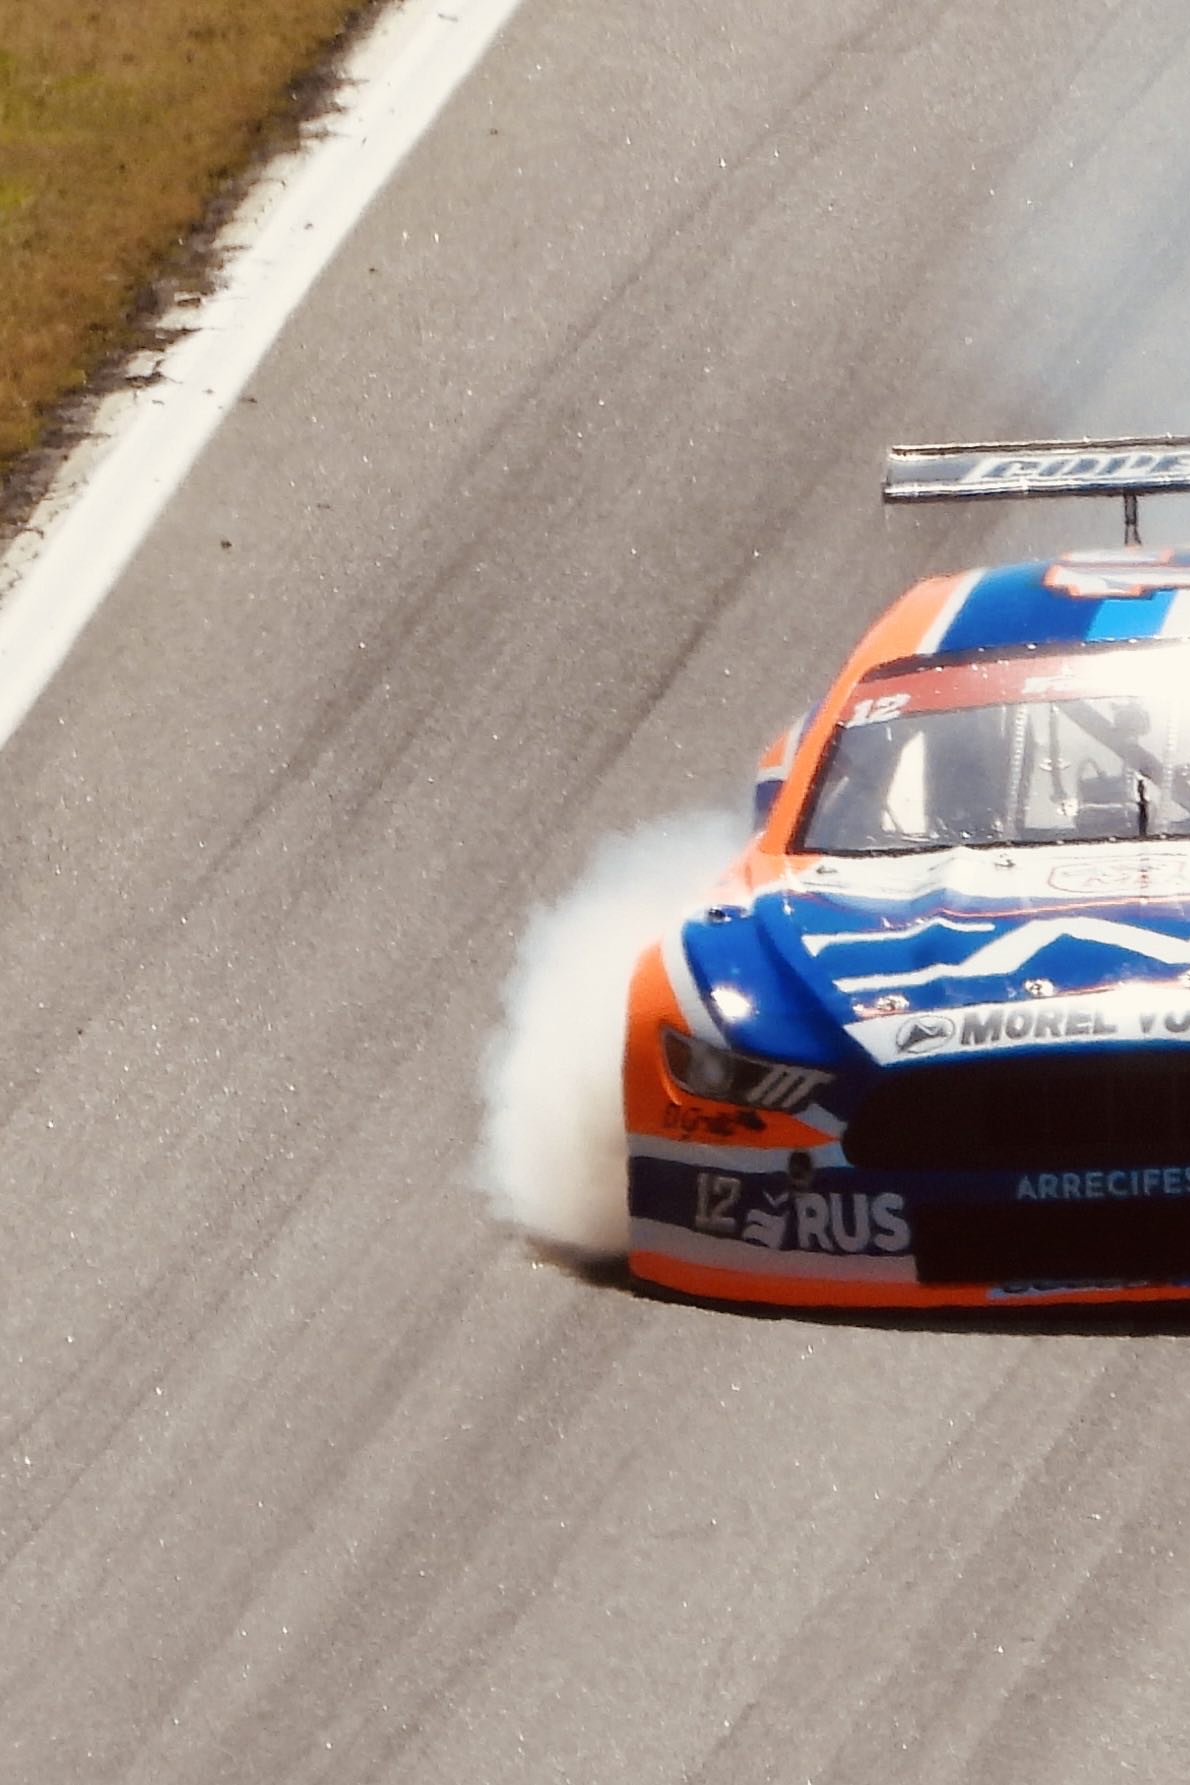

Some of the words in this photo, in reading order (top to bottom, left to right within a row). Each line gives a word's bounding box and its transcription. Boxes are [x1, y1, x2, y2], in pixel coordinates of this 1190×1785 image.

[845, 693, 912, 728] 12
[961, 1009, 1118, 1047] MOREL
[695, 1172, 742, 1233] 12
[796, 1191, 912, 1252] RUS
